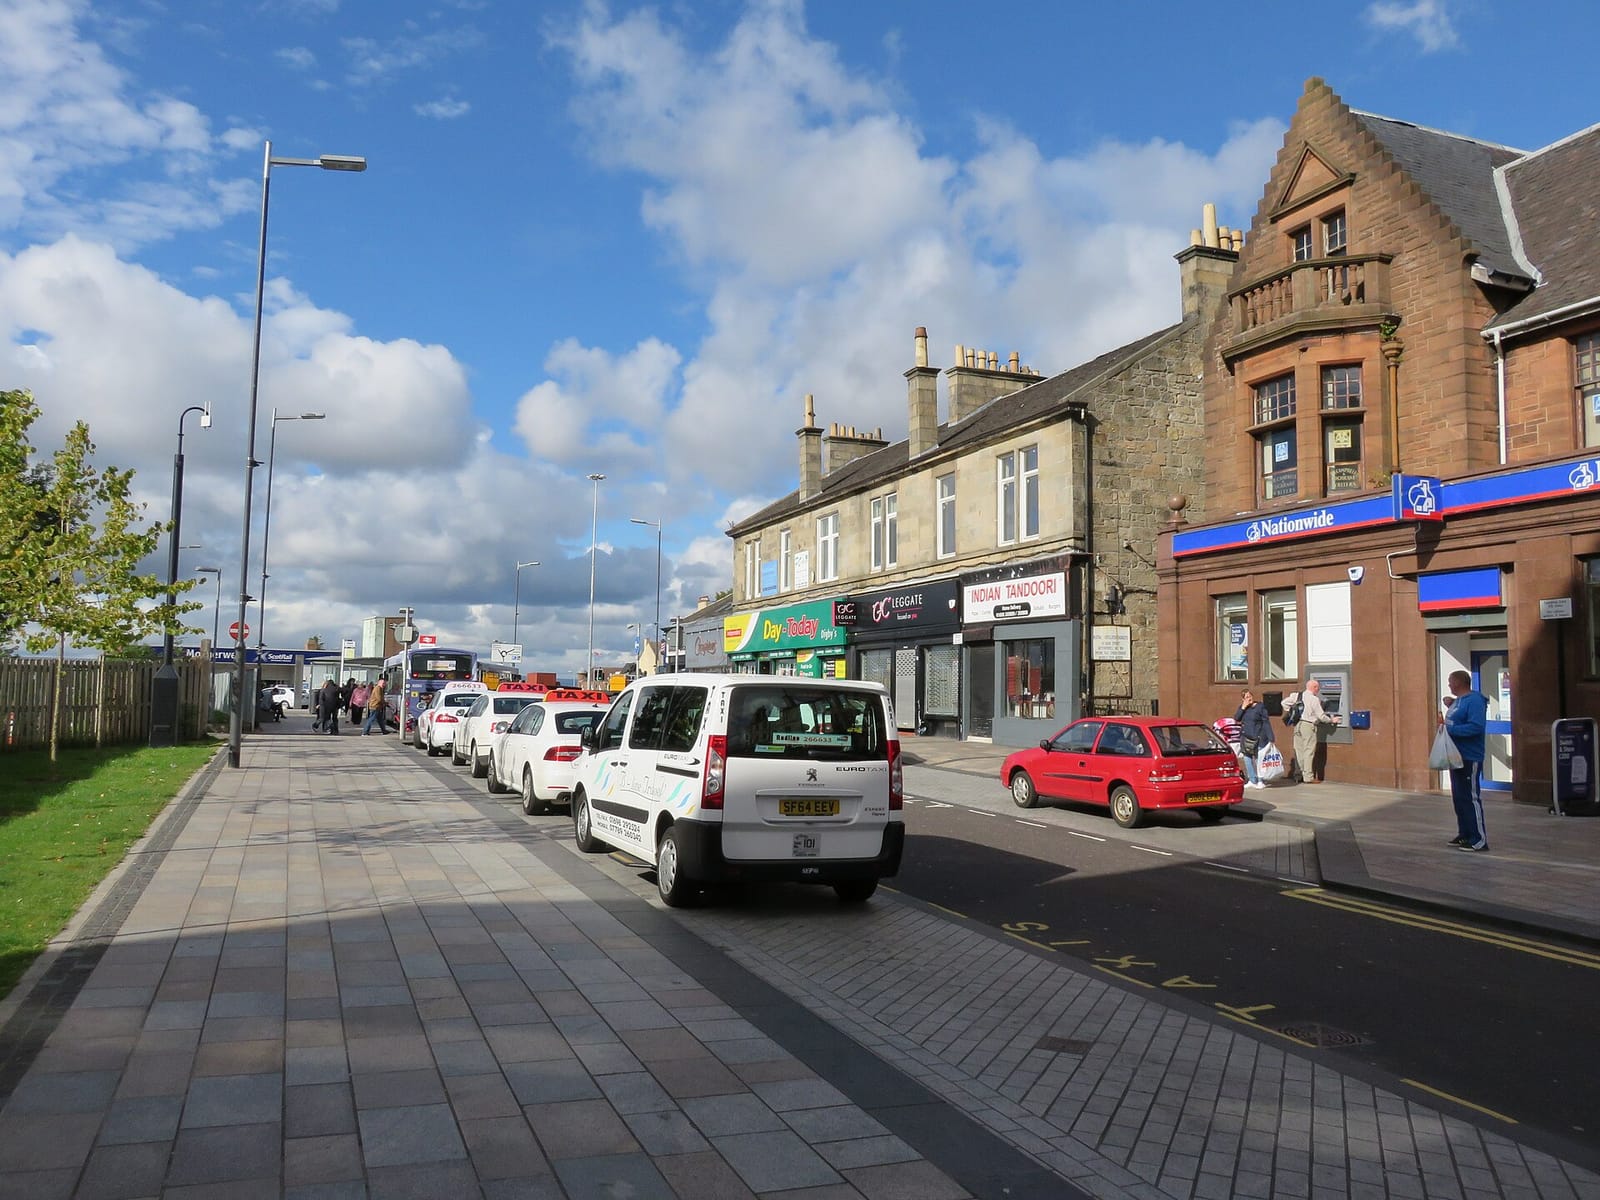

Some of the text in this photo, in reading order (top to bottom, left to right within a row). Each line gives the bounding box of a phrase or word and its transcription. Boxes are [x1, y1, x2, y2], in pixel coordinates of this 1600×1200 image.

[1261, 509, 1334, 537] Nationwide
[971, 578, 1057, 603] INDIAN TANDOORI
[891, 593, 923, 609] LEGGATE
[820, 627, 838, 641] Digby's
[268, 653, 294, 661] ScotRail
[505, 683, 545, 692] TAXI
[554, 690, 603, 701] TAXI
[783, 800, 835, 813] SF64 EEV
